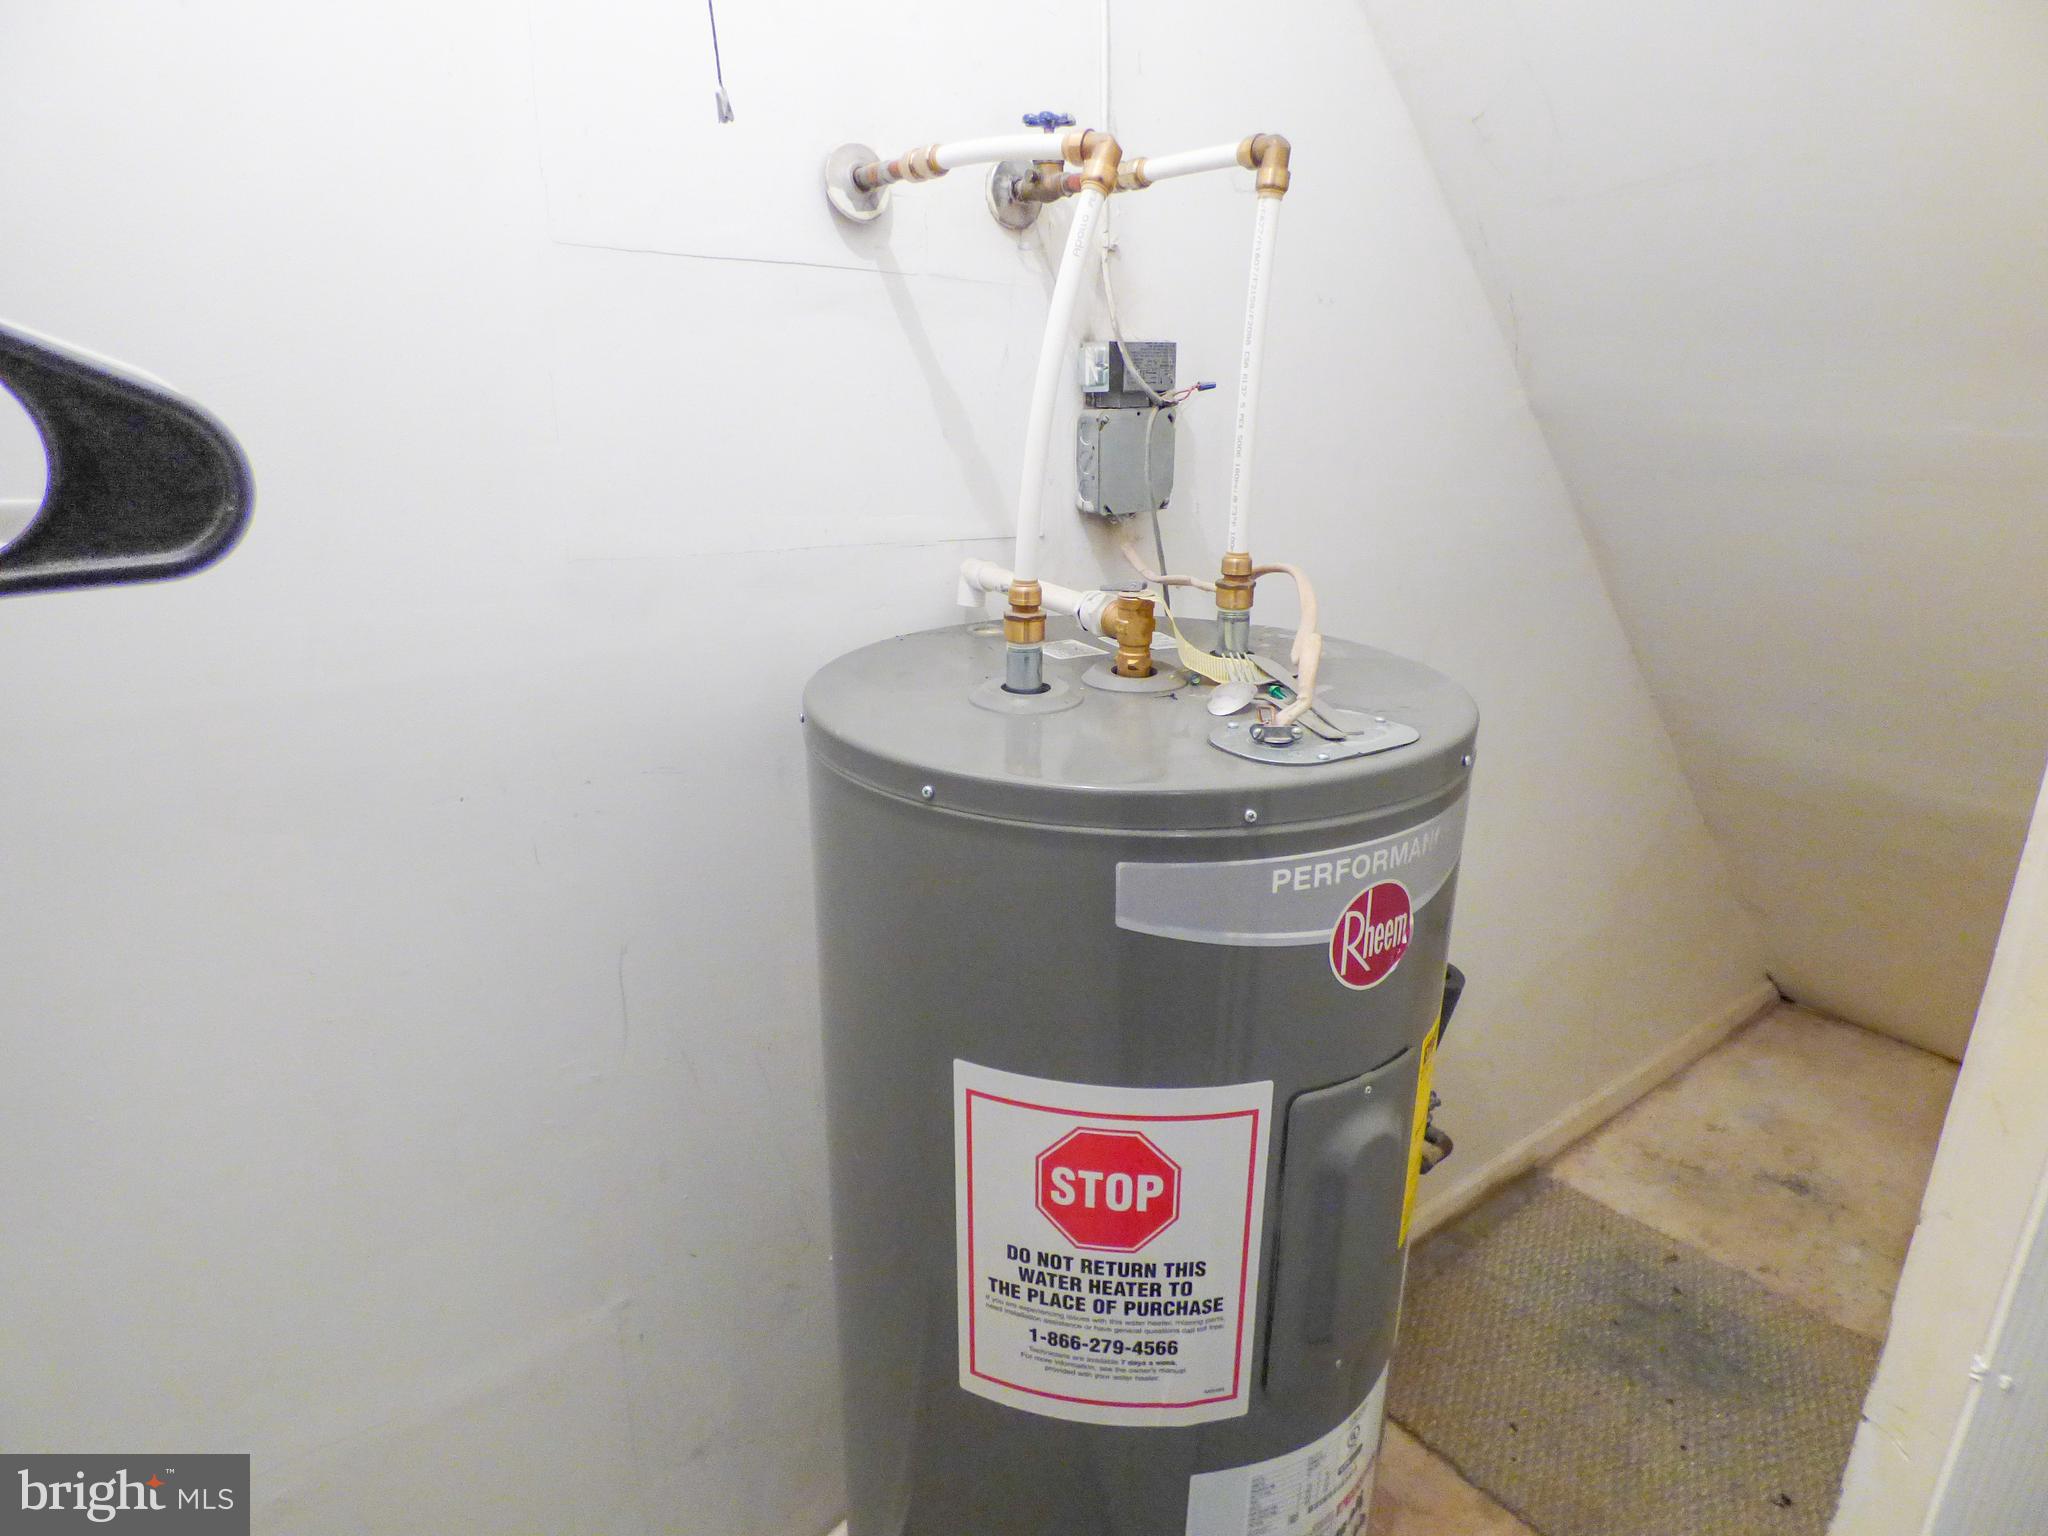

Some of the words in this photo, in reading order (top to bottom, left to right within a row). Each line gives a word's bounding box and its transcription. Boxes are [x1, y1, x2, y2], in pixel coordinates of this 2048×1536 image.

[1072, 214, 1090, 257] Apollo
[1271, 824, 1441, 894] PERFORMAN
[1341, 887, 1408, 975] Rheem
[1050, 1165, 1164, 1213] STOP
[1007, 1244, 1031, 1264] DO
[1037, 1250, 1074, 1272] NOT
[1081, 1258, 1158, 1279] RETURN
[1163, 1260, 1207, 1278] THIS
[1018, 1266, 1082, 1292] WATER
[1089, 1278, 1162, 1297] HEATER
[1170, 1280, 1193, 1296] TO
[988, 1276, 1021, 1300] THE
[1027, 1286, 1086, 1312] PLACE
[1092, 1298, 1117, 1316] OF
[1124, 1297, 1224, 1317] PURCHASE
[1028, 1327, 1179, 1356] 1-866-279-4566
